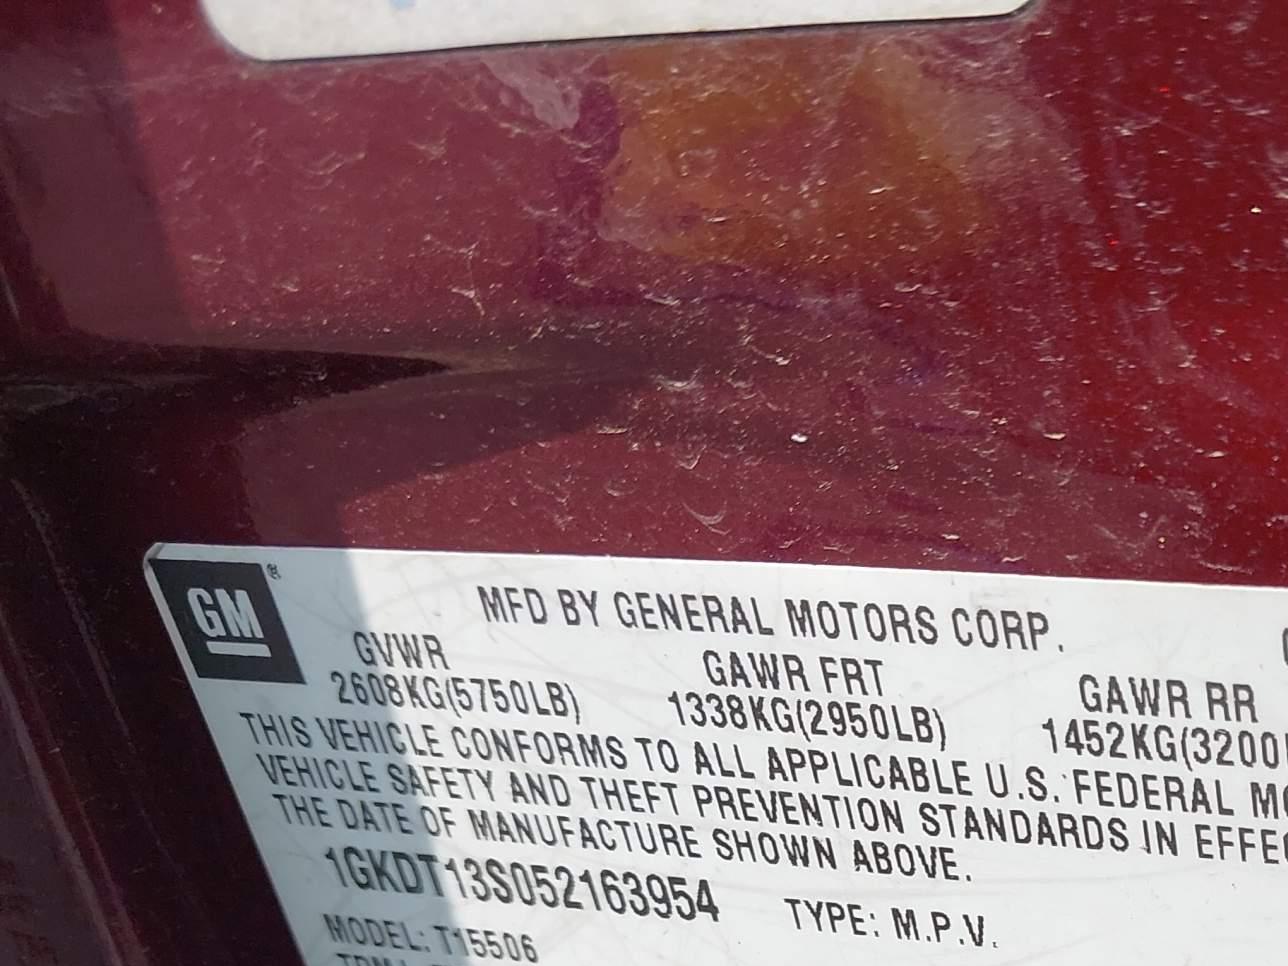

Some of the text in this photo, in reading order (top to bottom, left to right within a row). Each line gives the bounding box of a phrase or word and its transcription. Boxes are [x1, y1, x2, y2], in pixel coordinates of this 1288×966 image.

[188, 587, 263, 639] GM
[477, 586, 1064, 652] MFD BY GENERAL MOTORS CORP.
[353, 631, 450, 670] GVWR
[703, 650, 883, 696] GAWR FRT
[331, 671, 580, 725] 2608KG(5750LB)
[668, 691, 946, 752] 1338KG(2950LB)
[1079, 674, 1258, 723] GAWR RR
[238, 712, 312, 748] THIS
[315, 717, 444, 758] VEHICLE
[451, 726, 627, 769] CONFORMS
[633, 738, 679, 773] TO
[694, 741, 756, 779] ALL
[768, 747, 973, 796] APPLICABLE
[985, 762, 1059, 803] U.S.
[1073, 769, 1234, 816] FEDERAL
[256, 753, 380, 793] VEHICLE
[387, 763, 495, 802] SAFETY
[509, 772, 571, 807] AND
[578, 776, 679, 816] THEFT
[692, 785, 904, 834] PREVENTION
[919, 803, 1129, 852] STANDARDS
[1141, 820, 1178, 856] IN
[272, 794, 971, 882] THE DATE OF MANUFACTURE SHOWN ABOVE.
[324, 846, 719, 926] 1GKDT13S052163954
[323, 914, 538, 963] MODEL: T15506
[784, 898, 998, 948] TYPE: M.P.V.
